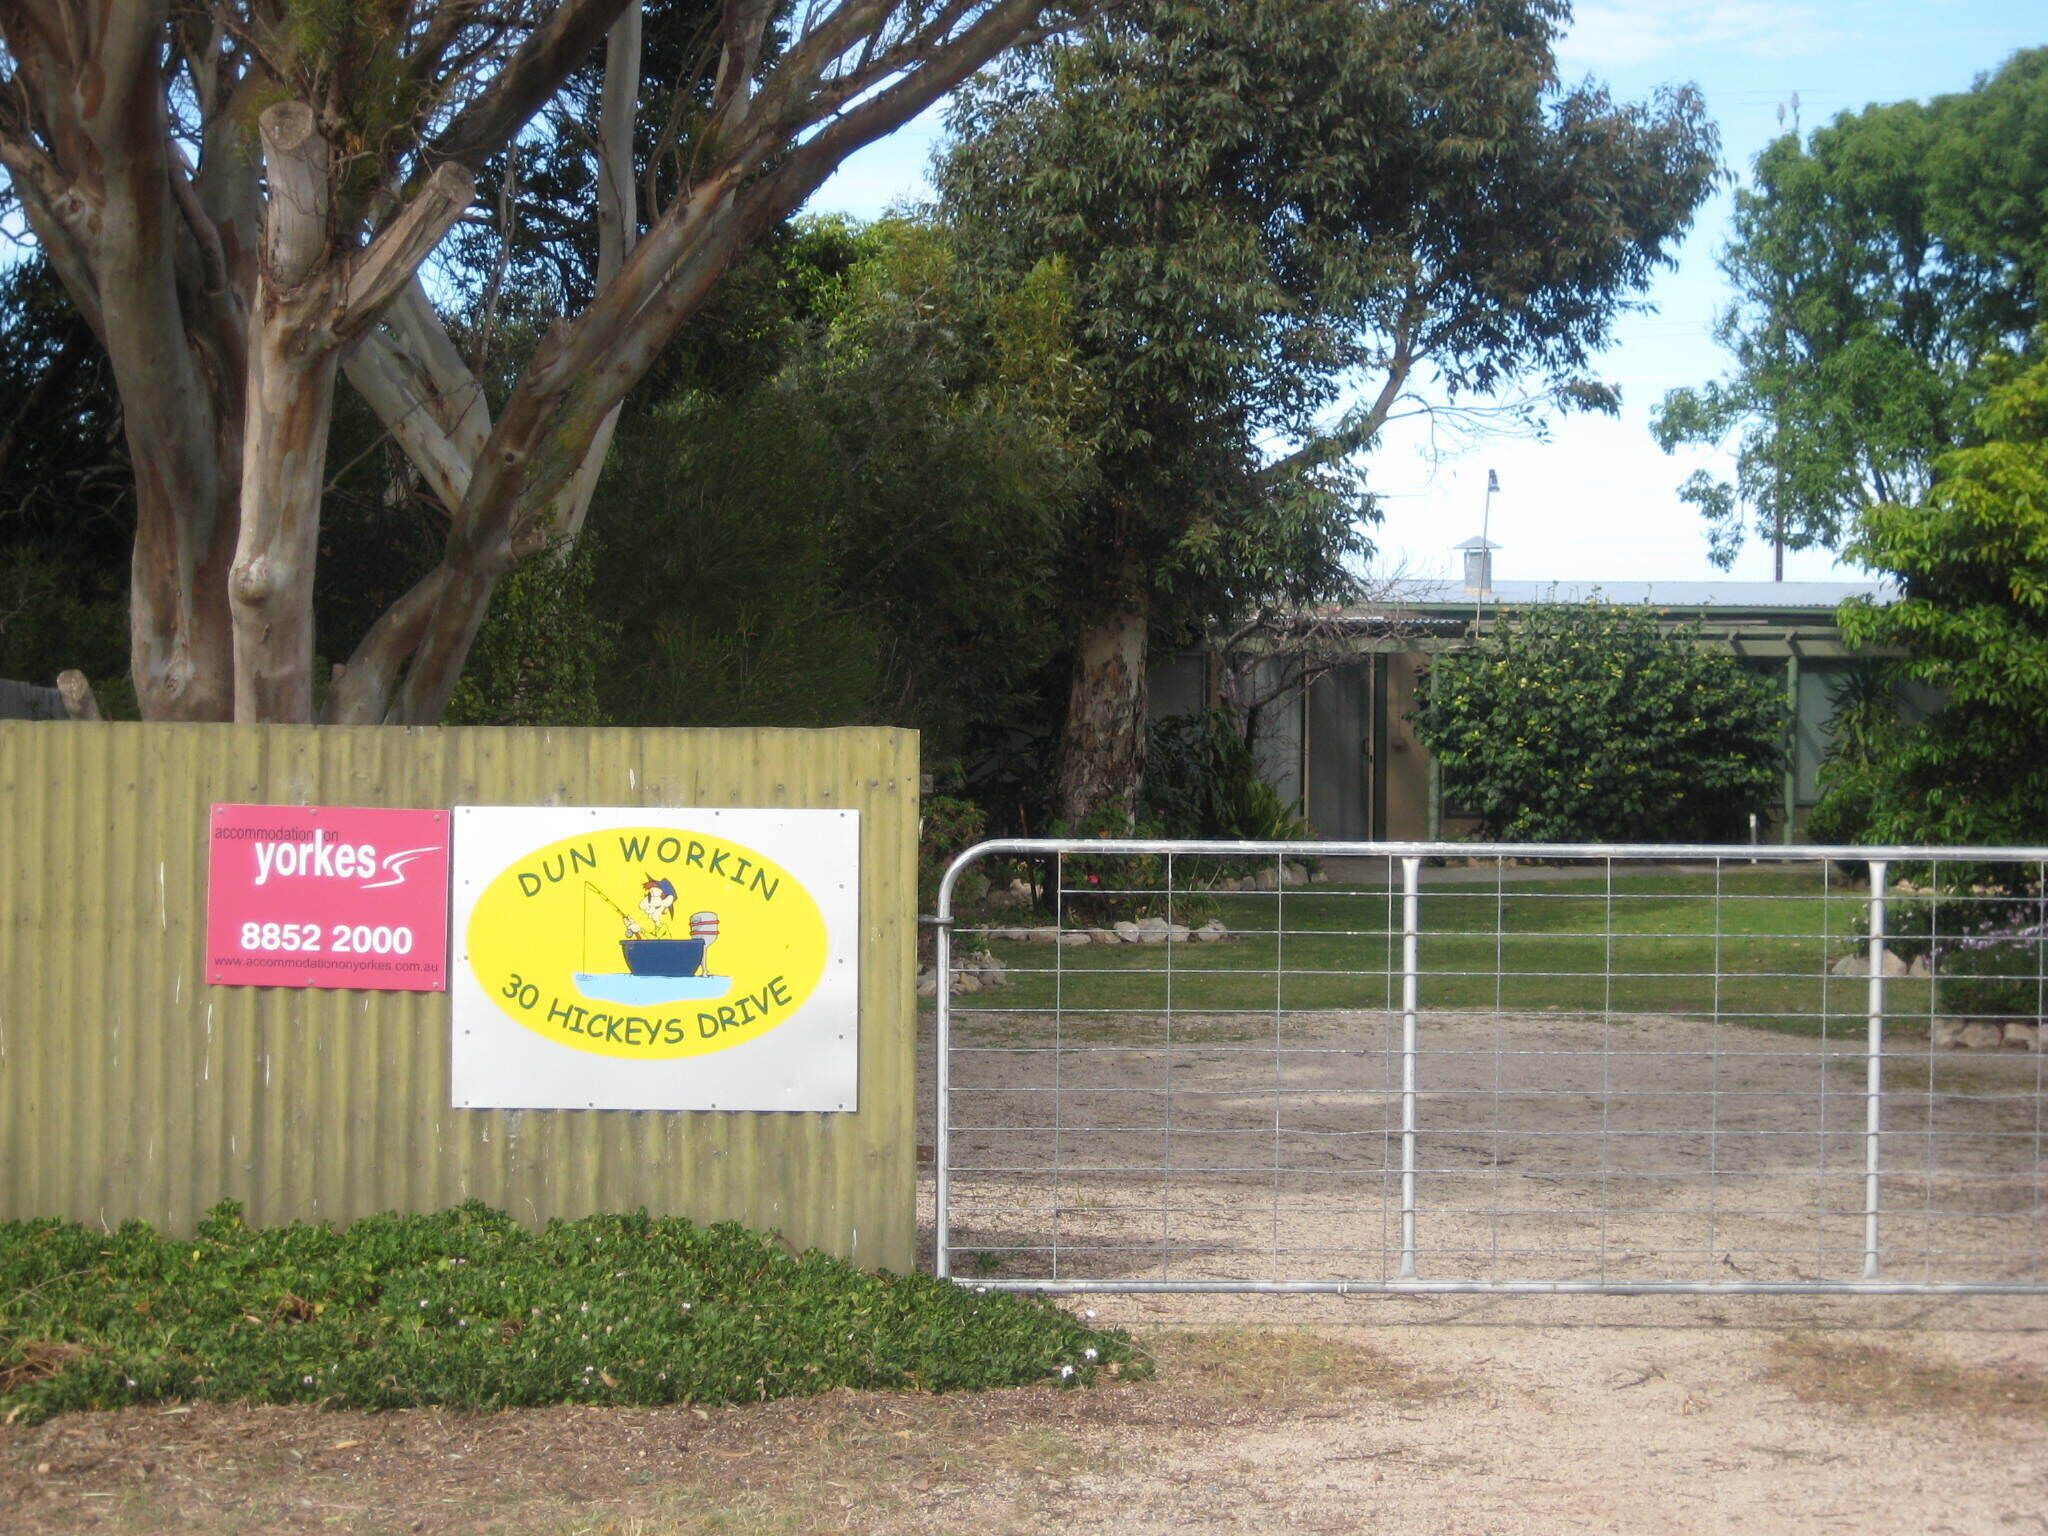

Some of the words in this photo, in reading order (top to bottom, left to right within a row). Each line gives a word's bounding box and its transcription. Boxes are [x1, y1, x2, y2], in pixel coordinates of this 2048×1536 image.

[215, 826, 314, 842] accommodation
[323, 830, 339, 842] on
[255, 829, 376, 885] yorkes
[518, 843, 597, 898] DUN
[619, 835, 780, 901] WORKIN
[241, 922, 321, 951] 8852
[331, 924, 413, 954] 2000
[214, 956, 438, 973] www.accommodationonyorkes.com.au
[502, 973, 539, 1010] 30
[547, 998, 684, 1045] HICKEYS
[697, 975, 793, 1039] DRIVE
